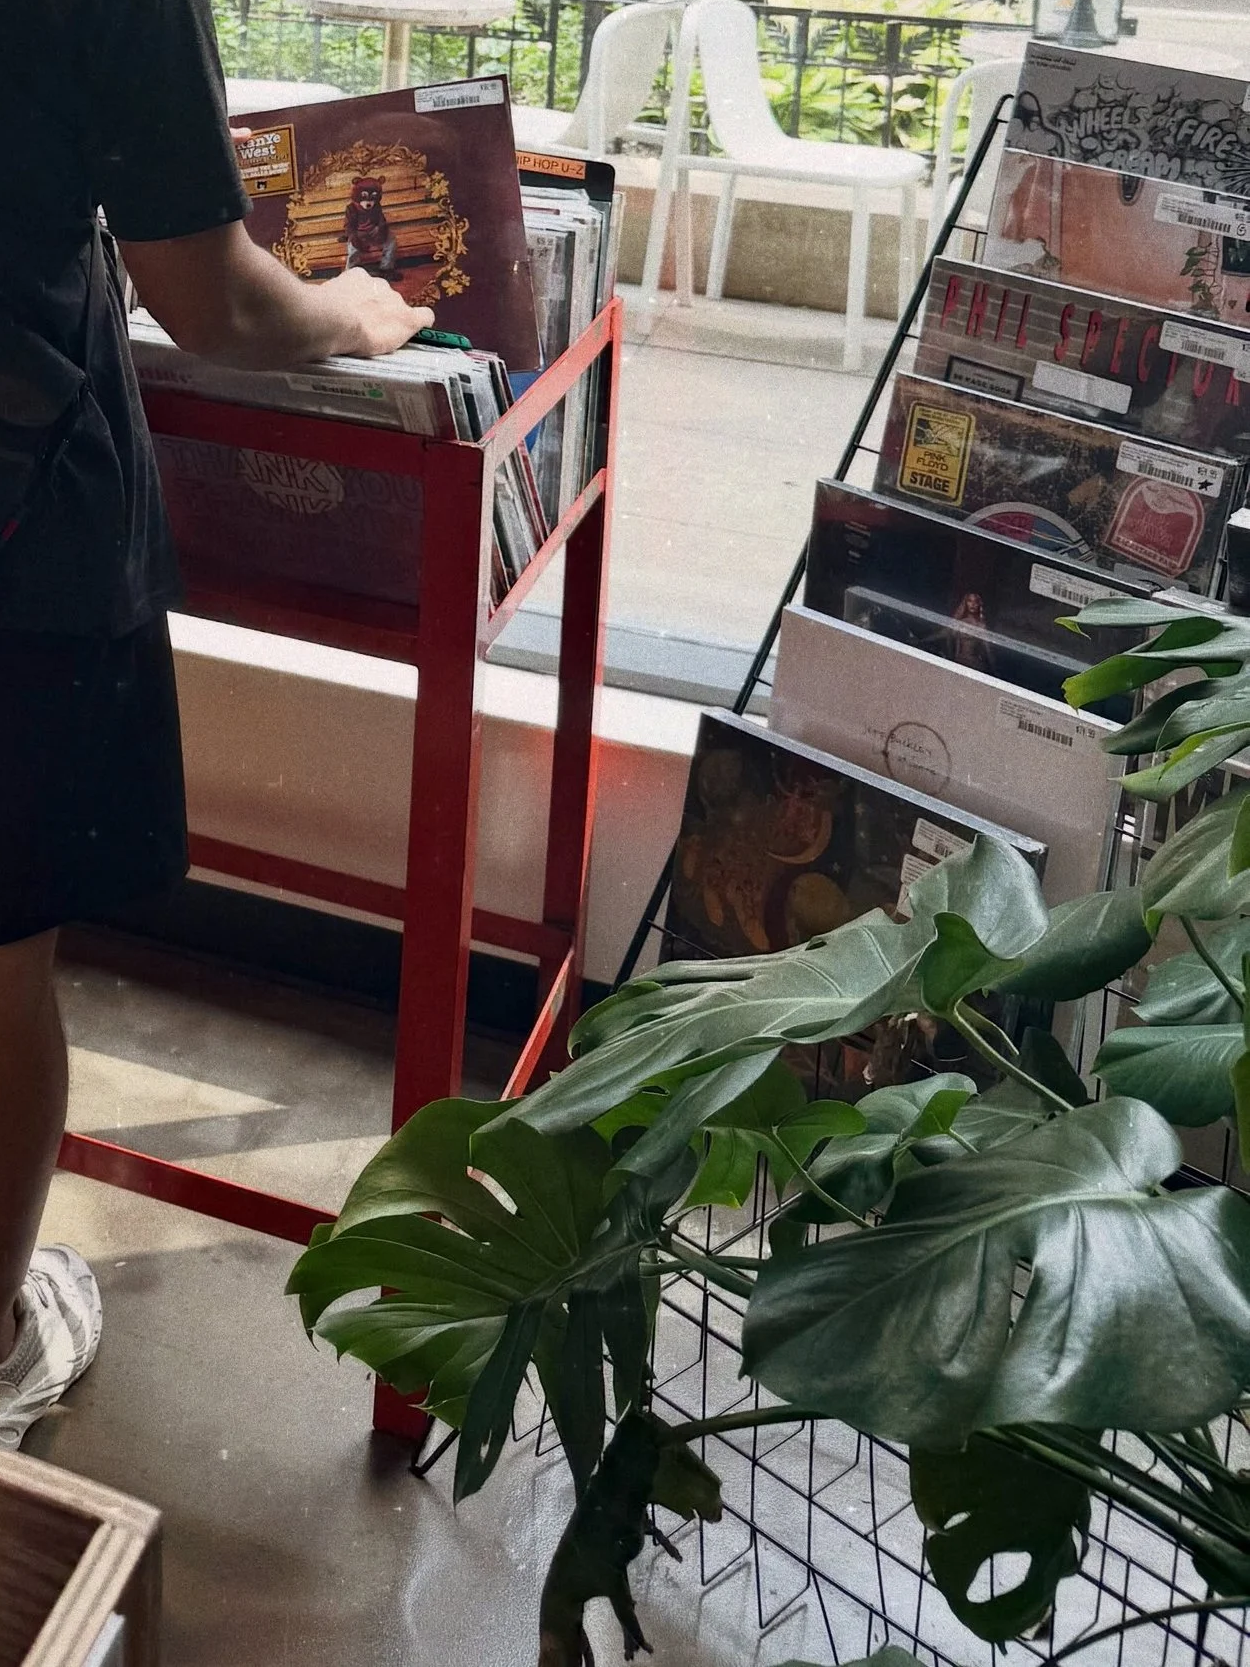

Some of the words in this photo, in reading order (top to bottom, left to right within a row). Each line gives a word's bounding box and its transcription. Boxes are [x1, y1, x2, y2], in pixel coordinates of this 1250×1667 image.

[240, 144, 276, 160] West
[533, 158, 559, 170] HOP
[940, 275, 1032, 349] PHIL
[923, 450, 947, 462] PINK
[916, 457, 949, 472] FLOYD
[909, 471, 950, 493] STAGE
